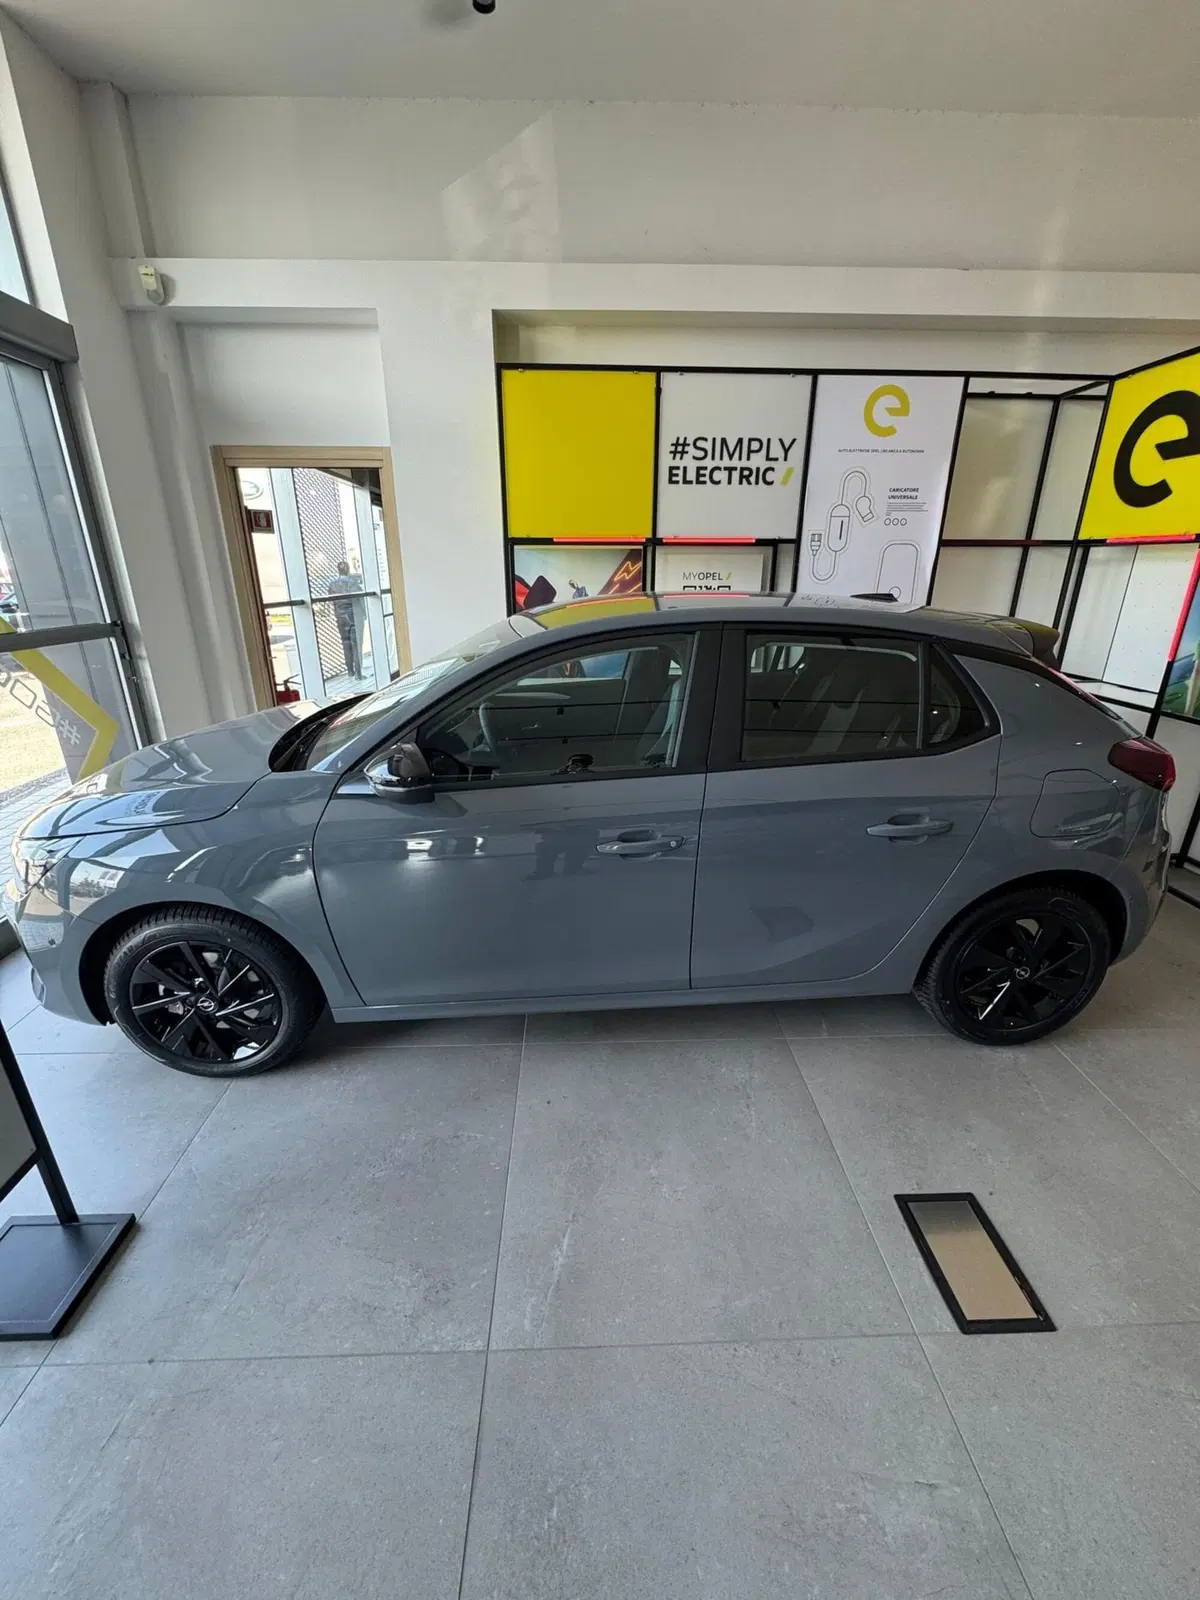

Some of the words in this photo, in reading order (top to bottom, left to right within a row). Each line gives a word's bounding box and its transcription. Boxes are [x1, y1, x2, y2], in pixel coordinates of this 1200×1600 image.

[669, 436, 797, 462] #SIMPLY
[668, 466, 775, 486] ELECTRIC
[682, 571, 723, 581] MYOPEL
